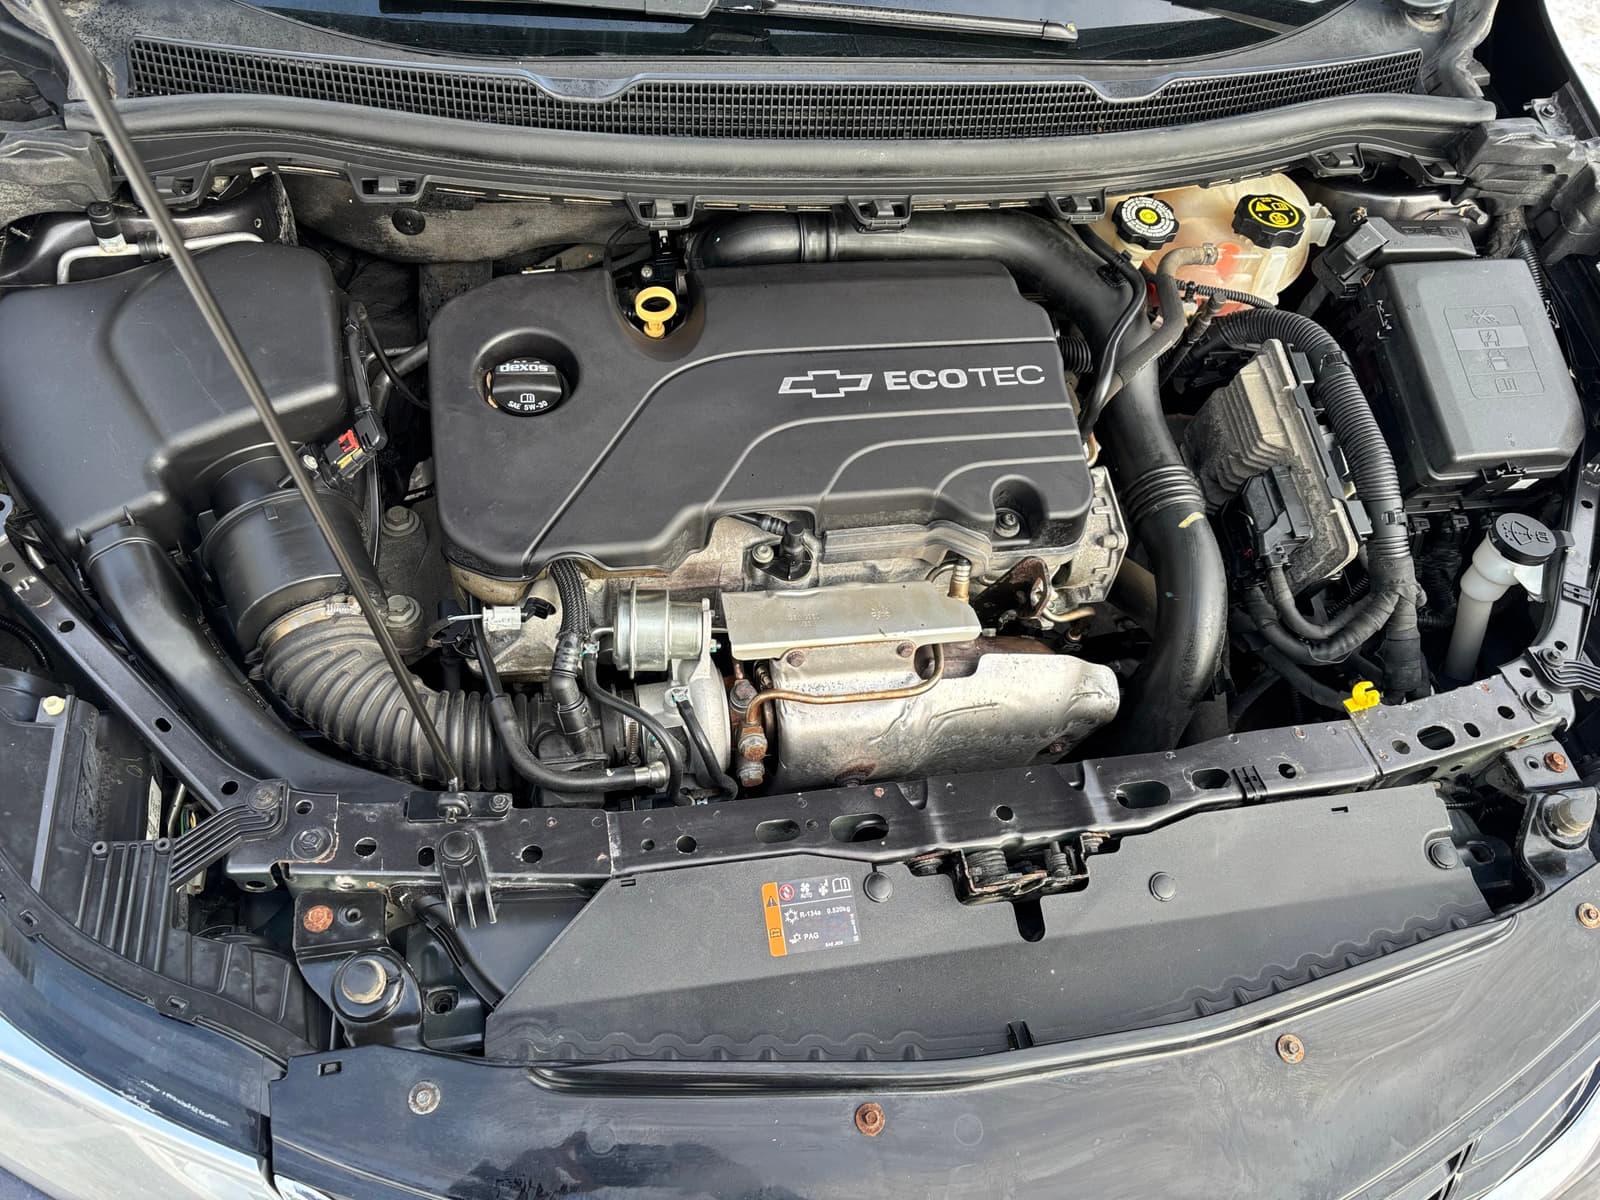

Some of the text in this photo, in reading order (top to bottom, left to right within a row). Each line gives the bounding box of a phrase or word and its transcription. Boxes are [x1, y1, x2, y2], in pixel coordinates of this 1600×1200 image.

[499, 363, 548, 372] dexos
[883, 365, 1046, 390] ECOTEC
[507, 400, 548, 411] SAE 5W-30
[799, 909, 821, 918] R-134a
[803, 932, 819, 941] PAG
